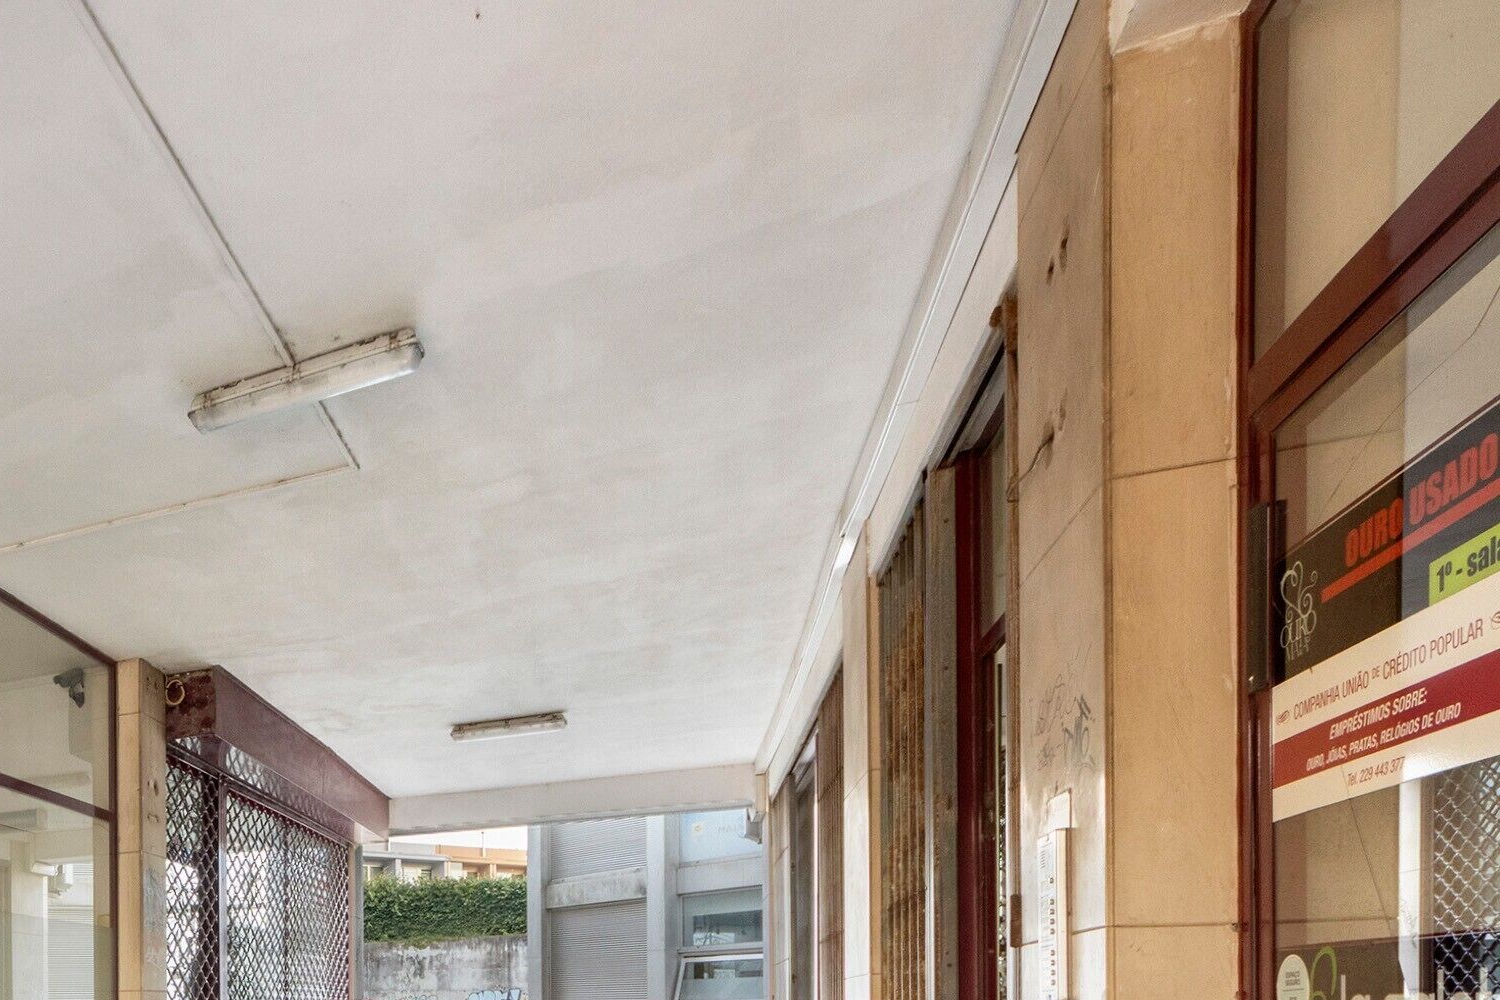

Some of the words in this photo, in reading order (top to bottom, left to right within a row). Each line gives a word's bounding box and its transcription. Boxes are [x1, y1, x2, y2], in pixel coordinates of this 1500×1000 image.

[1344, 497, 1404, 568] OURO
[1408, 432, 1499, 526] USADO
[1293, 685, 1341, 720] COMPANHIA
[1342, 670, 1370, 699] UNIÃO
[1382, 644, 1428, 680] CRÉDITO
[1429, 618, 1485, 660] POPULAR
[1329, 701, 1391, 741] EMPRÉSTIMOS
[1392, 687, 1429, 716] SOBRE:
[1348, 733, 1379, 757] PRATAS,
[1380, 717, 1420, 745] RELÓGIOS
[1421, 711, 1435, 731] DE
[1435, 701, 1462, 726] OURO
[1360, 765, 1374, 784] 229
